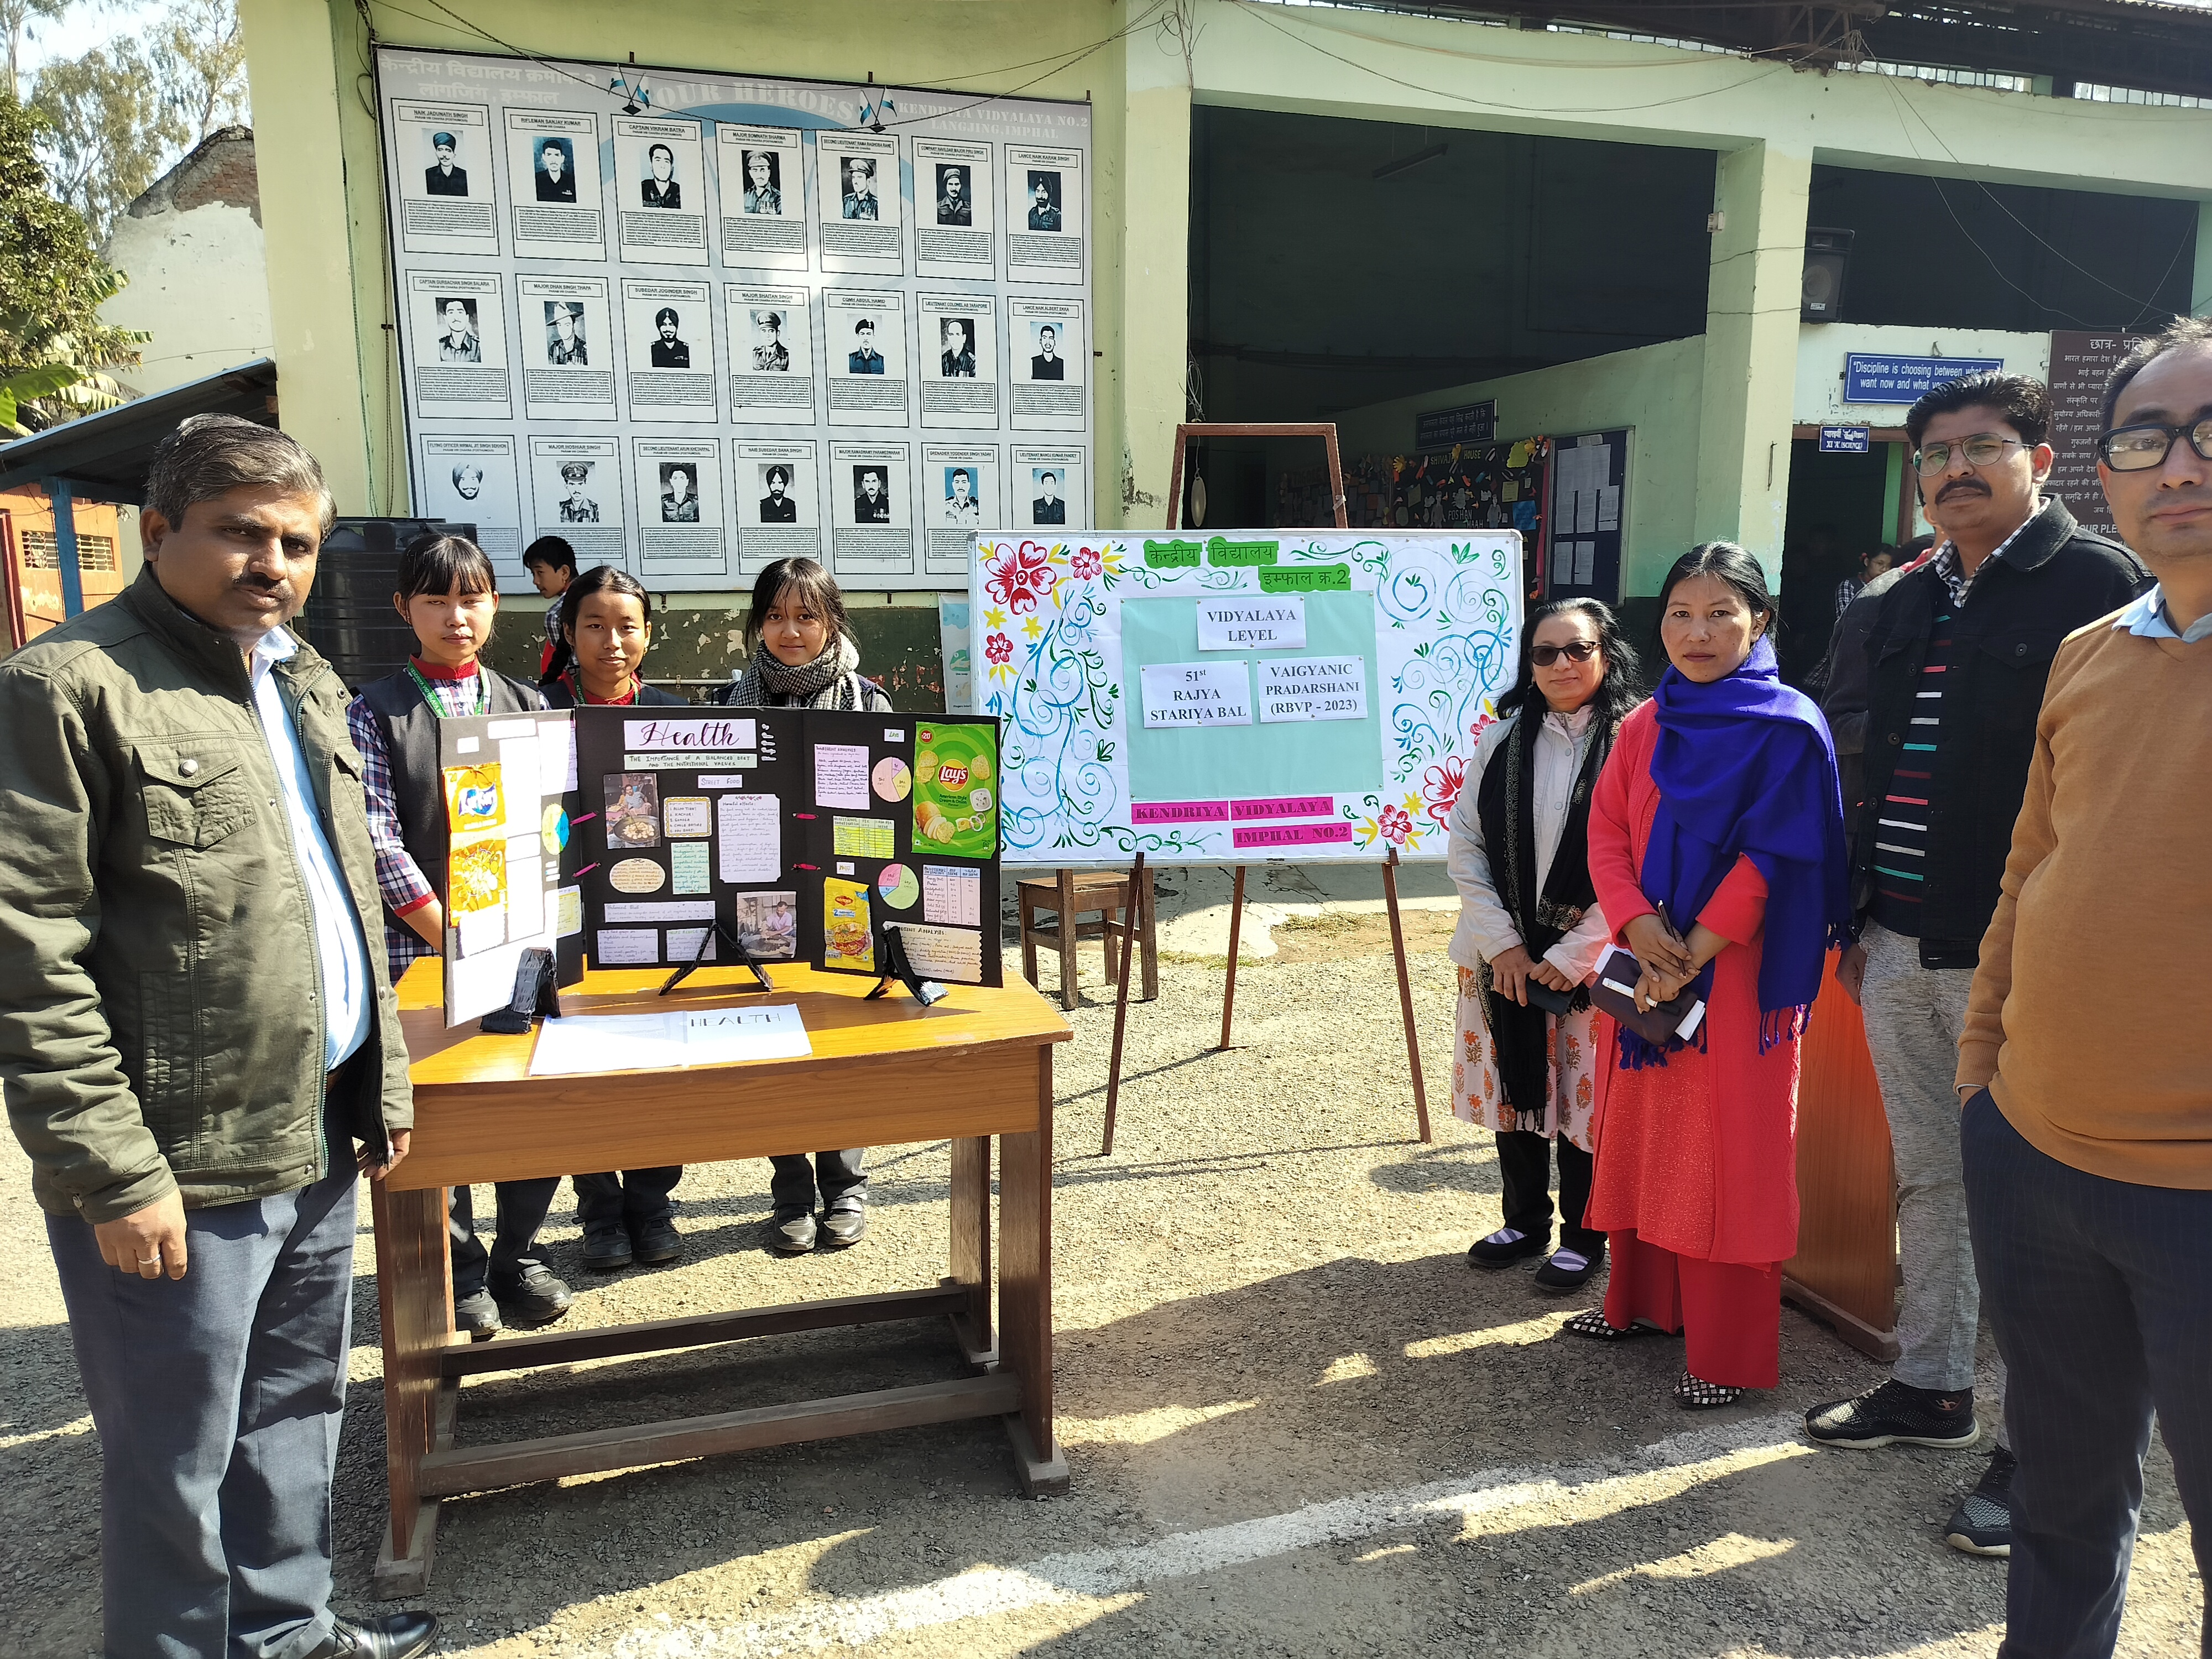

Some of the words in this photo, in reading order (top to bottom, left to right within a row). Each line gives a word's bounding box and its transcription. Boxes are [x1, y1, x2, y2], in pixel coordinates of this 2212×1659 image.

[656, 83, 722, 106] OUR
[733, 82, 853, 120] HEROES
[898, 102, 972, 119] KENDRIYA
[976, 107, 1053, 126] VIDYALAYA
[1057, 114, 1088, 128] NO.2
[2064, 354, 2080, 363] भारत
[2082, 355, 2099, 363] हमारा
[2100, 354, 2110, 363] देश
[1892, 363, 1898, 374] is
[1901, 363, 1932, 378] choosing
[1934, 364, 1963, 377] between
[2078, 367, 2090, 377] भाई
[1860, 378, 1877, 389] want
[1880, 379, 1894, 389] now
[1897, 379, 1911, 390] and
[1913, 379, 1929, 390] what
[2053, 381, 2068, 390] प्राणों
[2069, 382, 2075, 390] से
[2078, 382, 2085, 390] भी
[2066, 395, 2088, 407] संस्कृति
[2053, 409, 2074, 421] सुयोग्य
[2075, 409, 2101, 418] अधिकारी
[2085, 424, 2101, 432] अपने
[1463, 450, 1481, 460] HOUSE
[2062, 451, 2077, 460] सबके
[2057, 466, 2068, 474] हम
[2069, 465, 2084, 473] अपने
[2086, 465, 2096, 473] देश
[2067, 478, 2079, 488] रहने
[2081, 478, 2090, 487] की
[2092, 491, 2100, 501] ही
[1149, 544, 1198, 563] केन्द्रीय
[1211, 541, 1276, 560] विद्यालय
[1262, 568, 1313, 587] इम्फाल
[1207, 609, 1297, 623] VIDYALAYA
[1227, 628, 1278, 642] LEVEL
[1185, 668, 1207, 682] 51st
[1270, 664, 1353, 679] VAIGYANIC
[1173, 687, 1222, 702] RAJYA
[1265, 681, 1360, 696] PRADARSHANI
[1270, 701, 1313, 715] (RBVP
[1324, 698, 1358, 713] 2023)
[1150, 707, 1216, 722] STARIYA
[1218, 706, 1247, 718] BAL
[638, 722, 740, 747] Health
[940, 766, 967, 784] Lay's
[1135, 805, 1225, 820] KENDRIYA
[1234, 800, 1331, 816] VIDYALAYA
[1236, 829, 1304, 844] IMPHAL
[1312, 826, 1349, 839] NO.2
[691, 1013, 781, 1027] HEALTH
